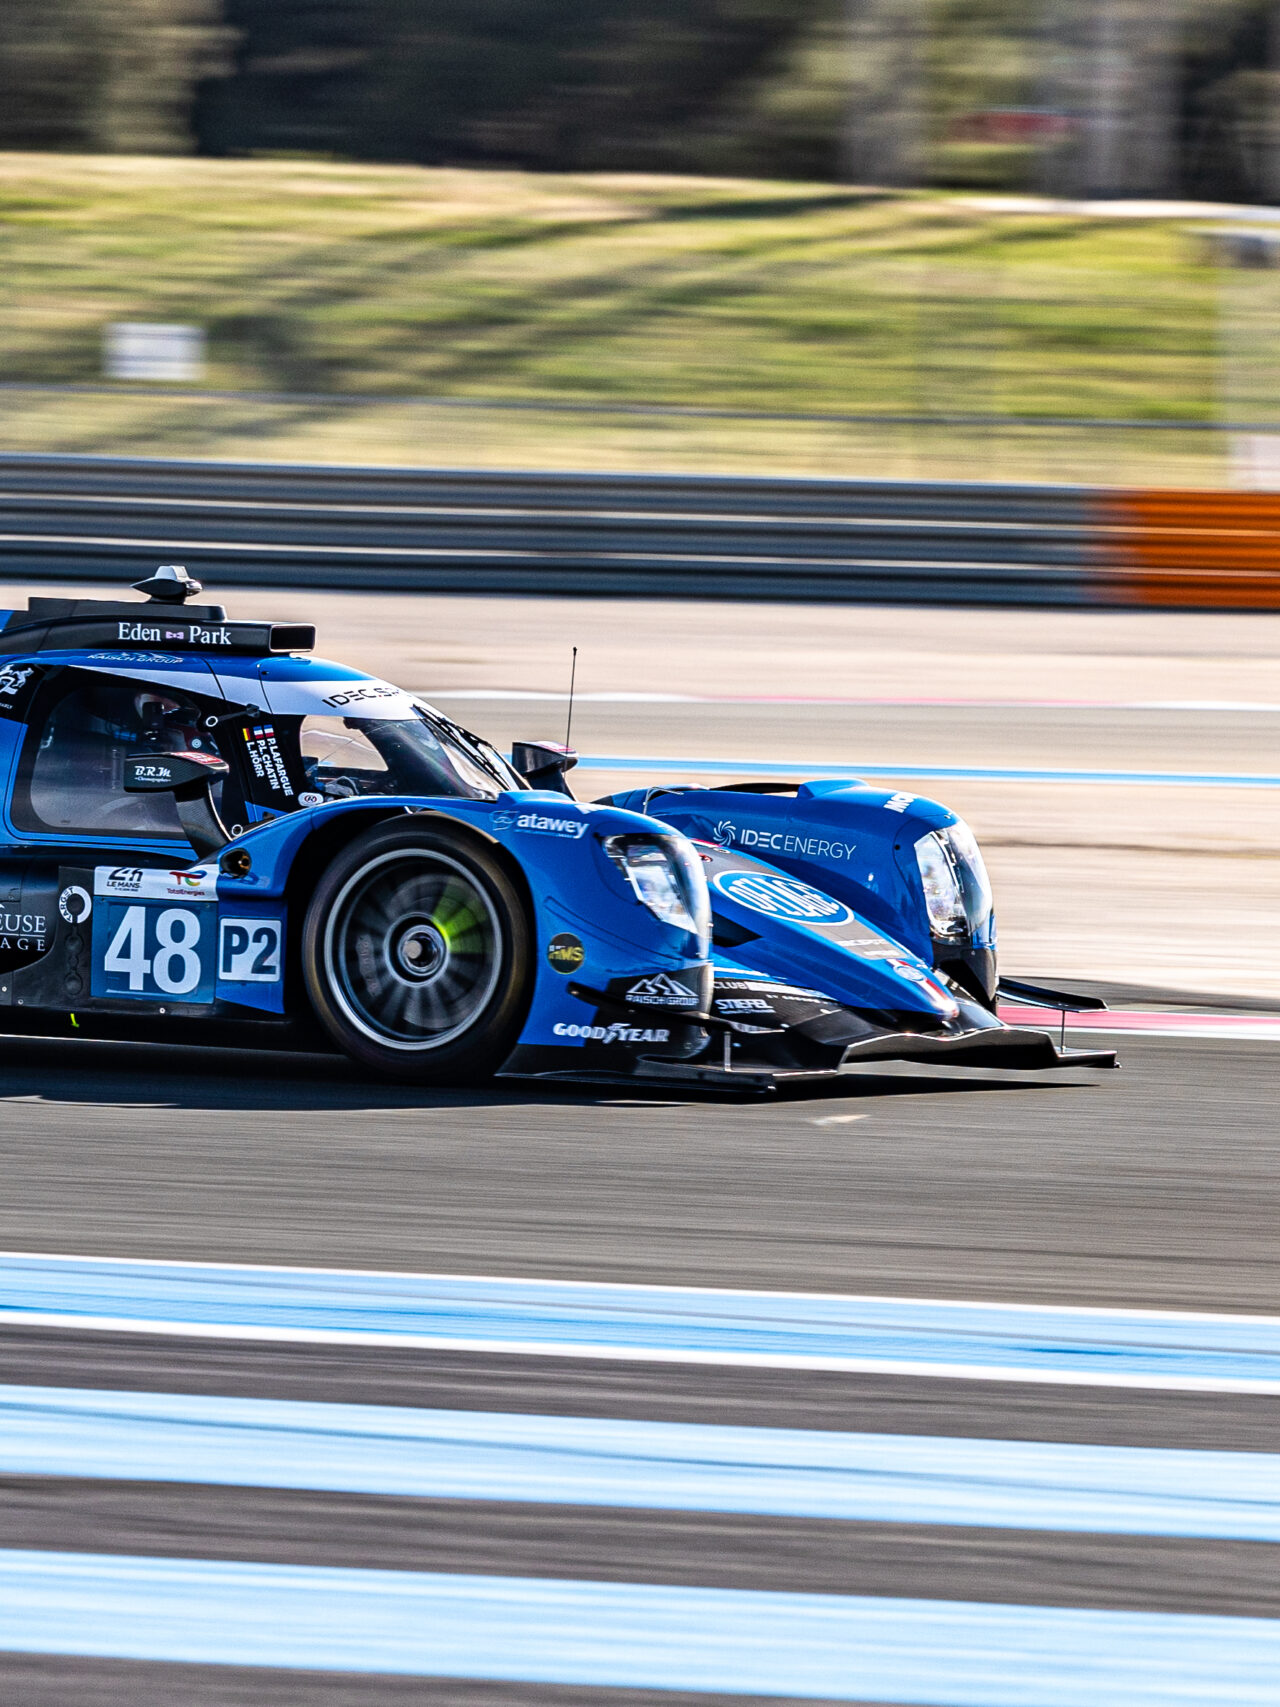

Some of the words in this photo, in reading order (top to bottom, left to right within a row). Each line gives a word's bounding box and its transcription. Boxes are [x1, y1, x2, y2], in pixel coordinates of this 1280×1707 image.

[118, 622, 162, 642] Eden
[188, 627, 232, 646] Park
[517, 813, 589, 839] atawey
[104, 906, 201, 994] 48
[222, 925, 277, 975] P2
[553, 1023, 670, 1044] GOODYEAR
